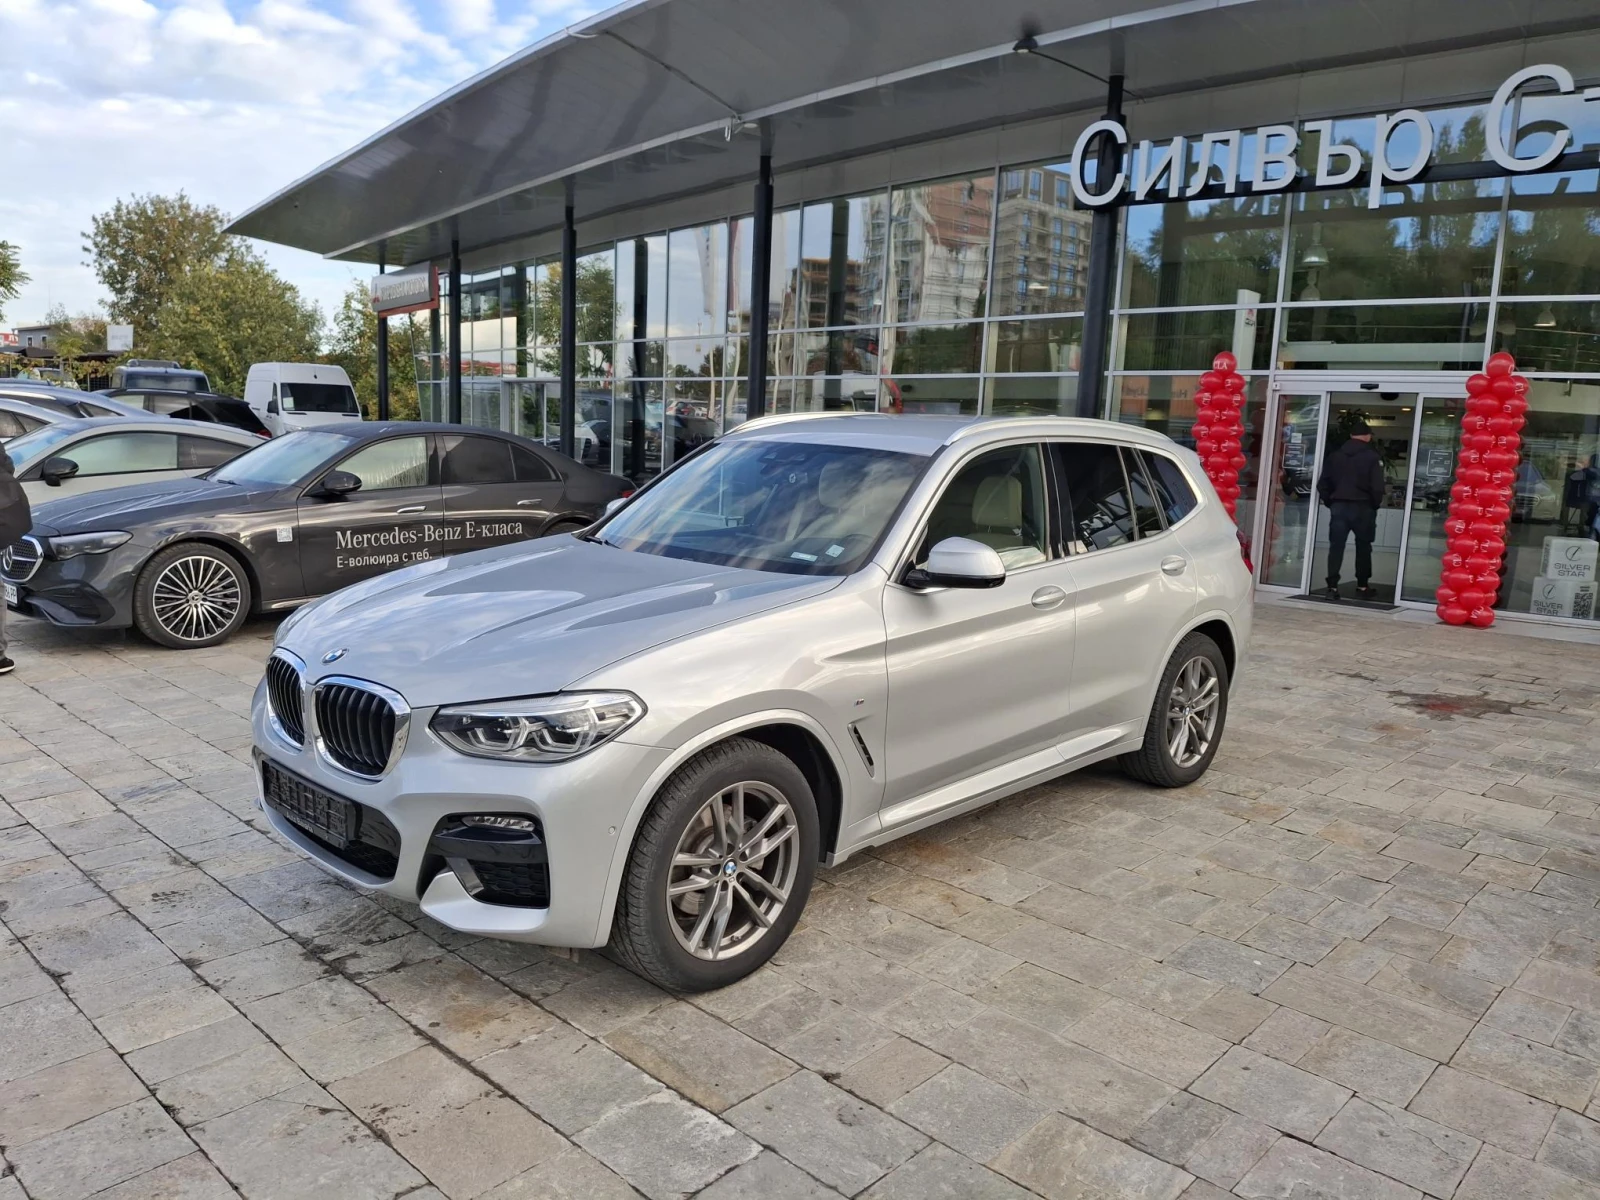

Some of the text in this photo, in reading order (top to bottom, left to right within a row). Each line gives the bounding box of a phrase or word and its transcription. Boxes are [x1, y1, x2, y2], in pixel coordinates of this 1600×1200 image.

[1070, 108, 1434, 209] Силвър
[336, 521, 523, 550] Mercedes-Benz Е-класа
[336, 551, 400, 568] Е-волюира
[402, 552, 408, 561] с
[1555, 563, 1590, 571] SILVER
[1558, 569, 1585, 577] STAR
[1534, 600, 1562, 609] SILVER
